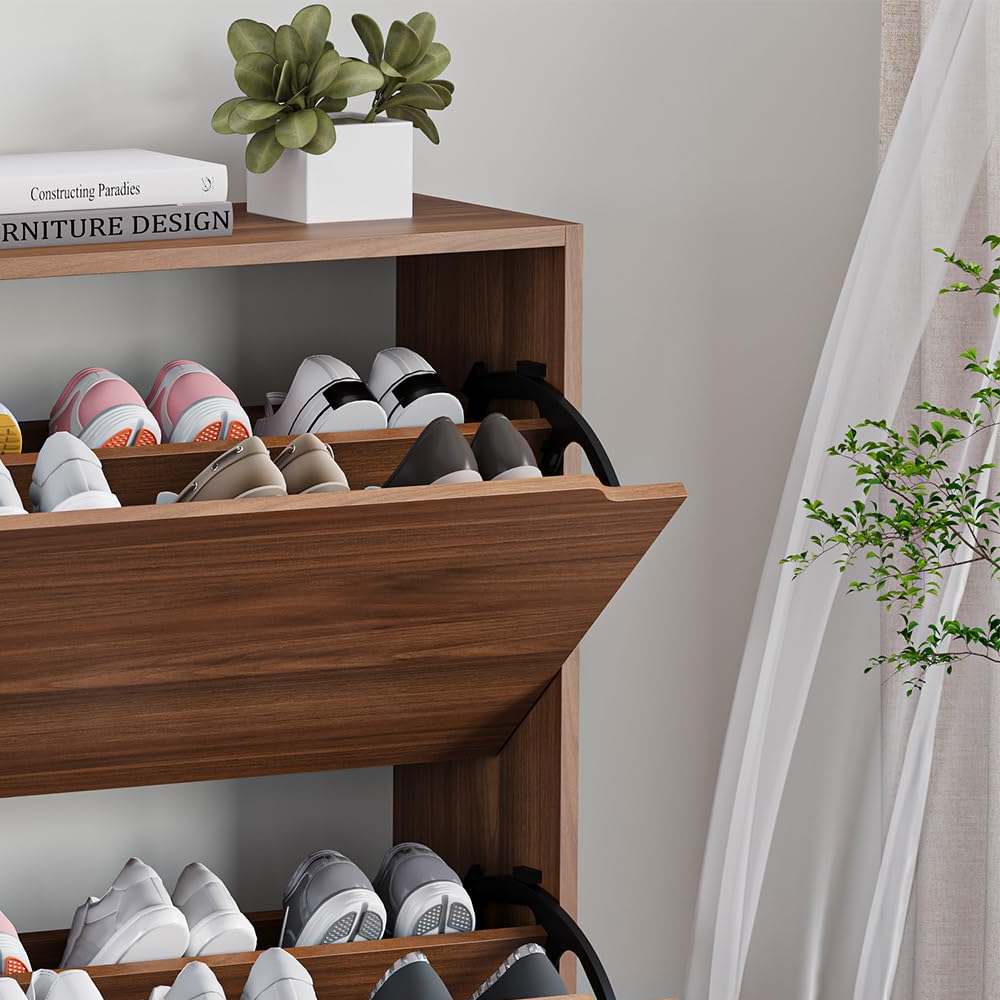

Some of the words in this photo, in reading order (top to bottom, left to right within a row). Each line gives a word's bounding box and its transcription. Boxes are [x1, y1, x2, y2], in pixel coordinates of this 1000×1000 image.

[30, 184, 95, 201] Constructing
[98, 181, 141, 197] Paradies
[131, 210, 231, 236] DESIGN
